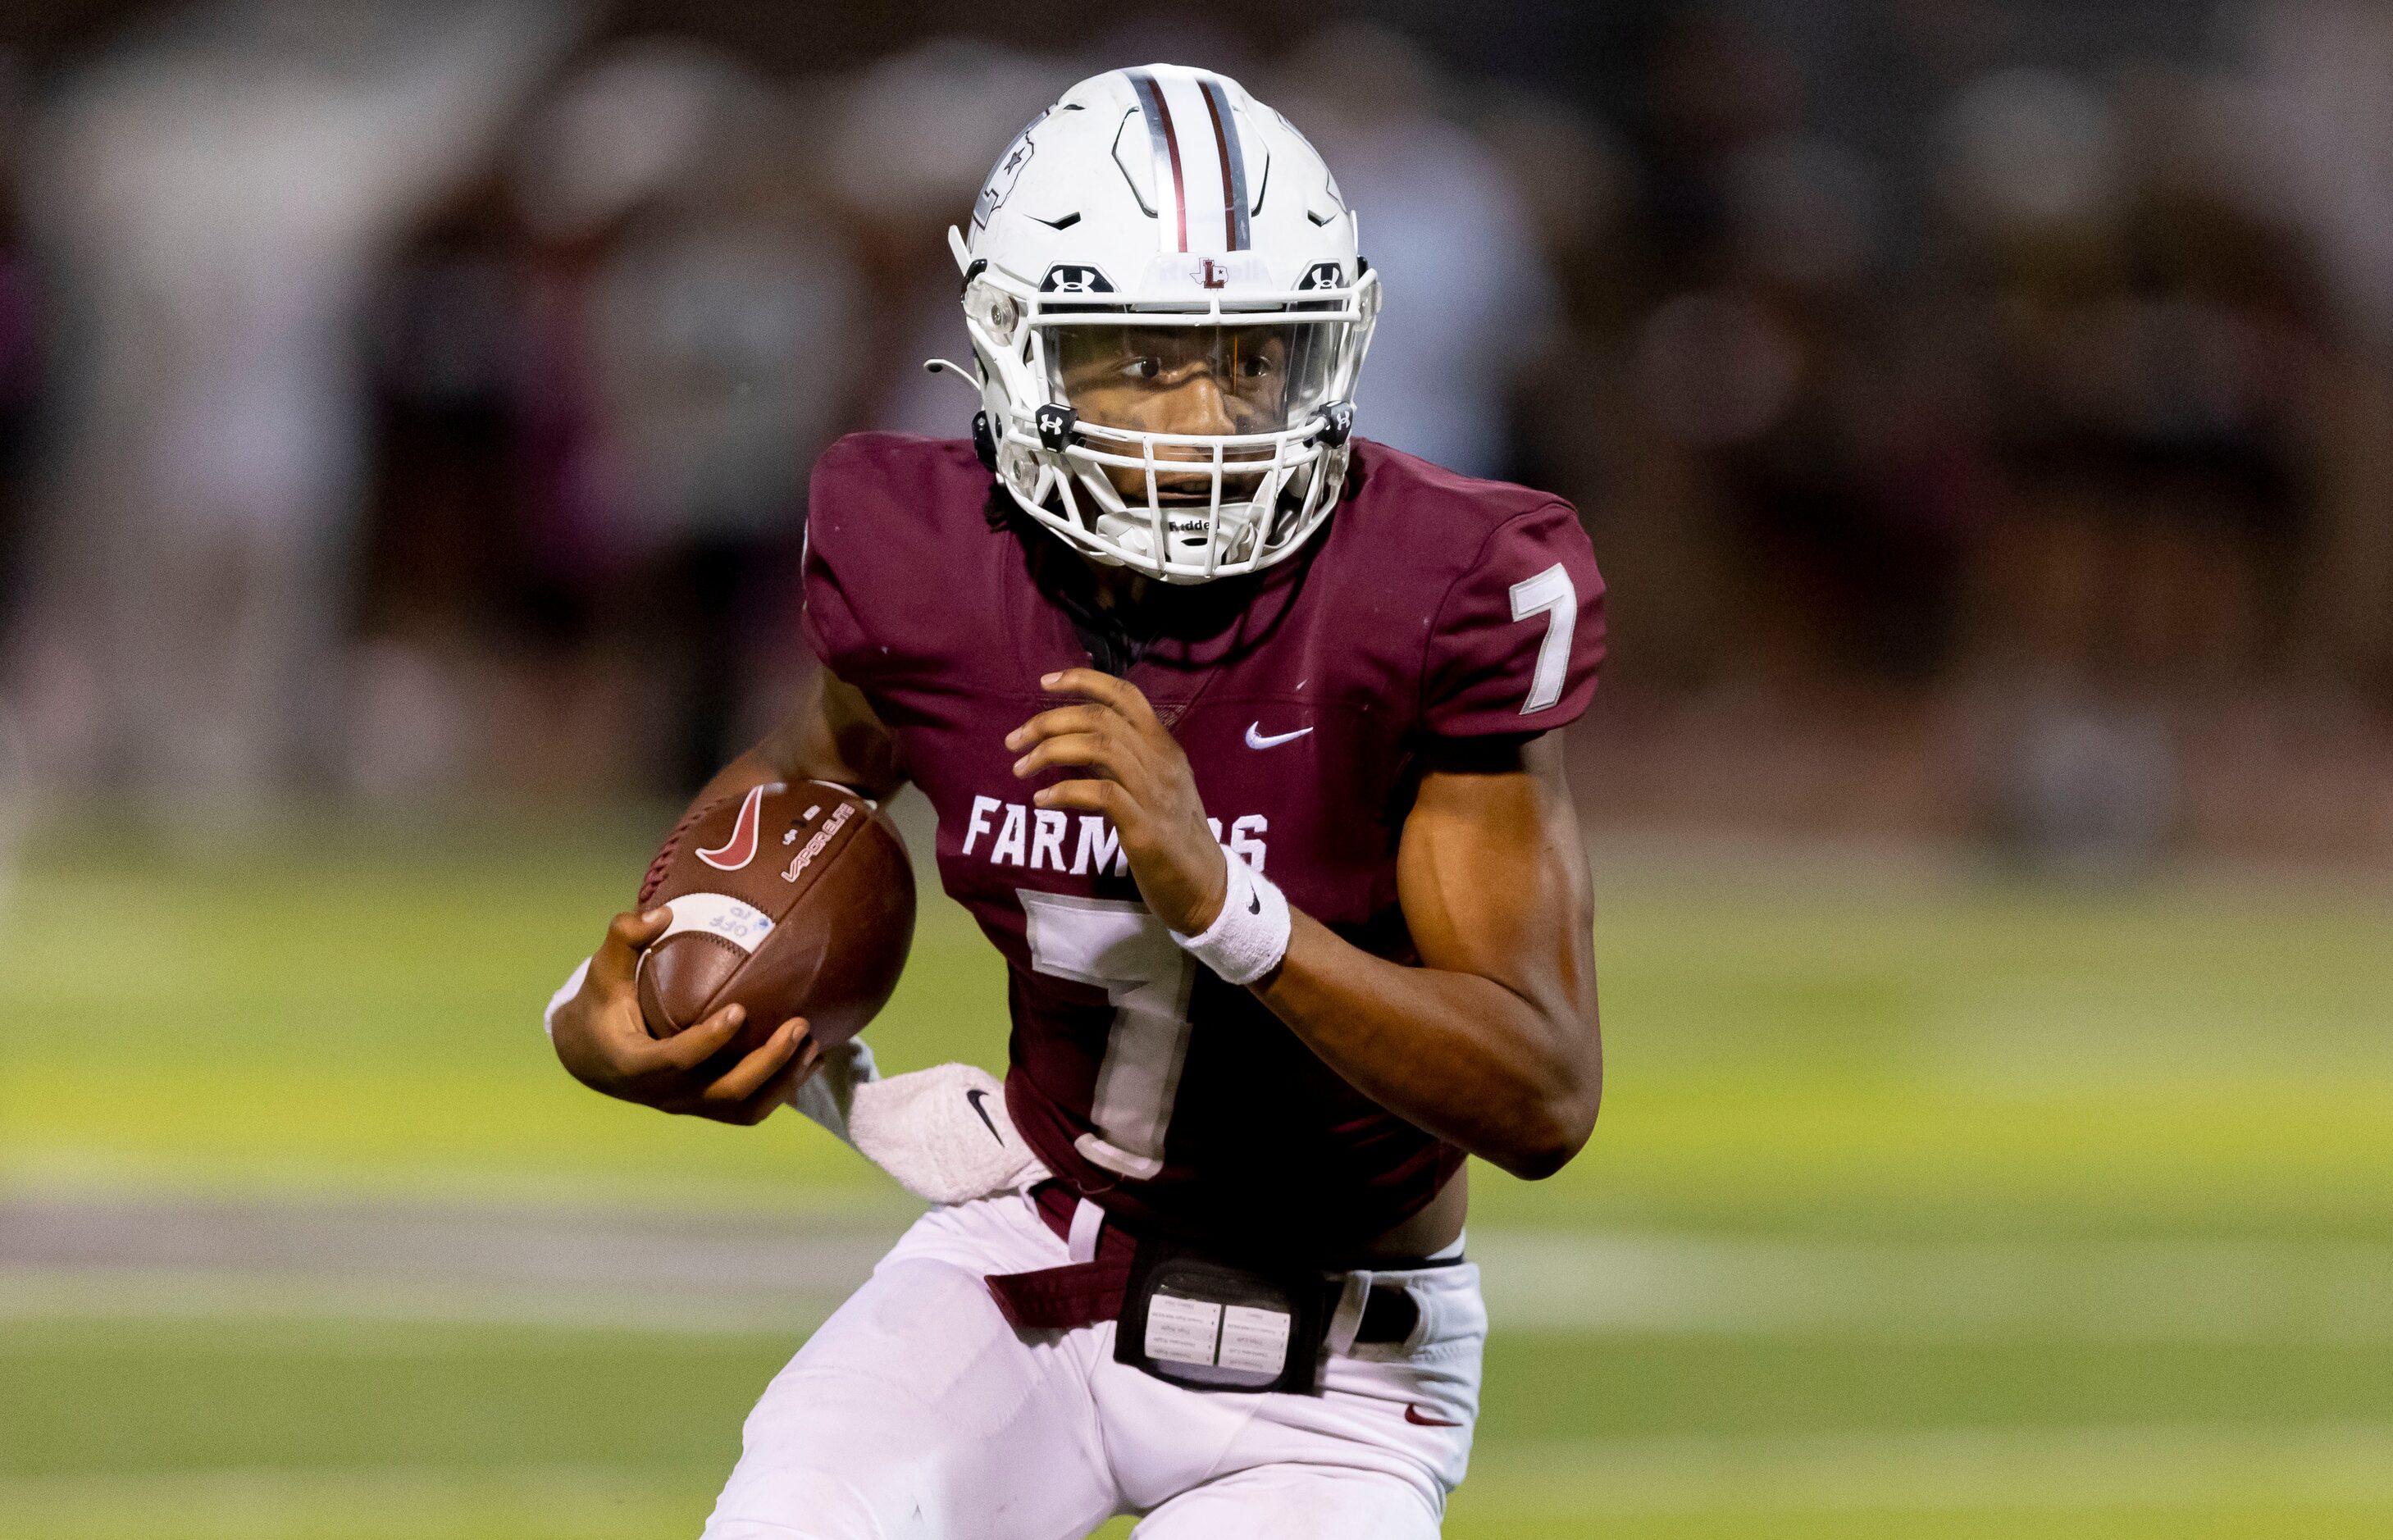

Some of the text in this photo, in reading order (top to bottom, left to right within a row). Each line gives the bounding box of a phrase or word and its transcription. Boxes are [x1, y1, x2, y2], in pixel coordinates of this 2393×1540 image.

[1202, 259, 1224, 289] L
[1509, 562, 1578, 715] 7
[781, 831, 832, 882] VAPOR
[822, 803, 855, 836] ELITE
[962, 795, 1268, 877] FARMS
[1015, 888, 1196, 1180] 7
